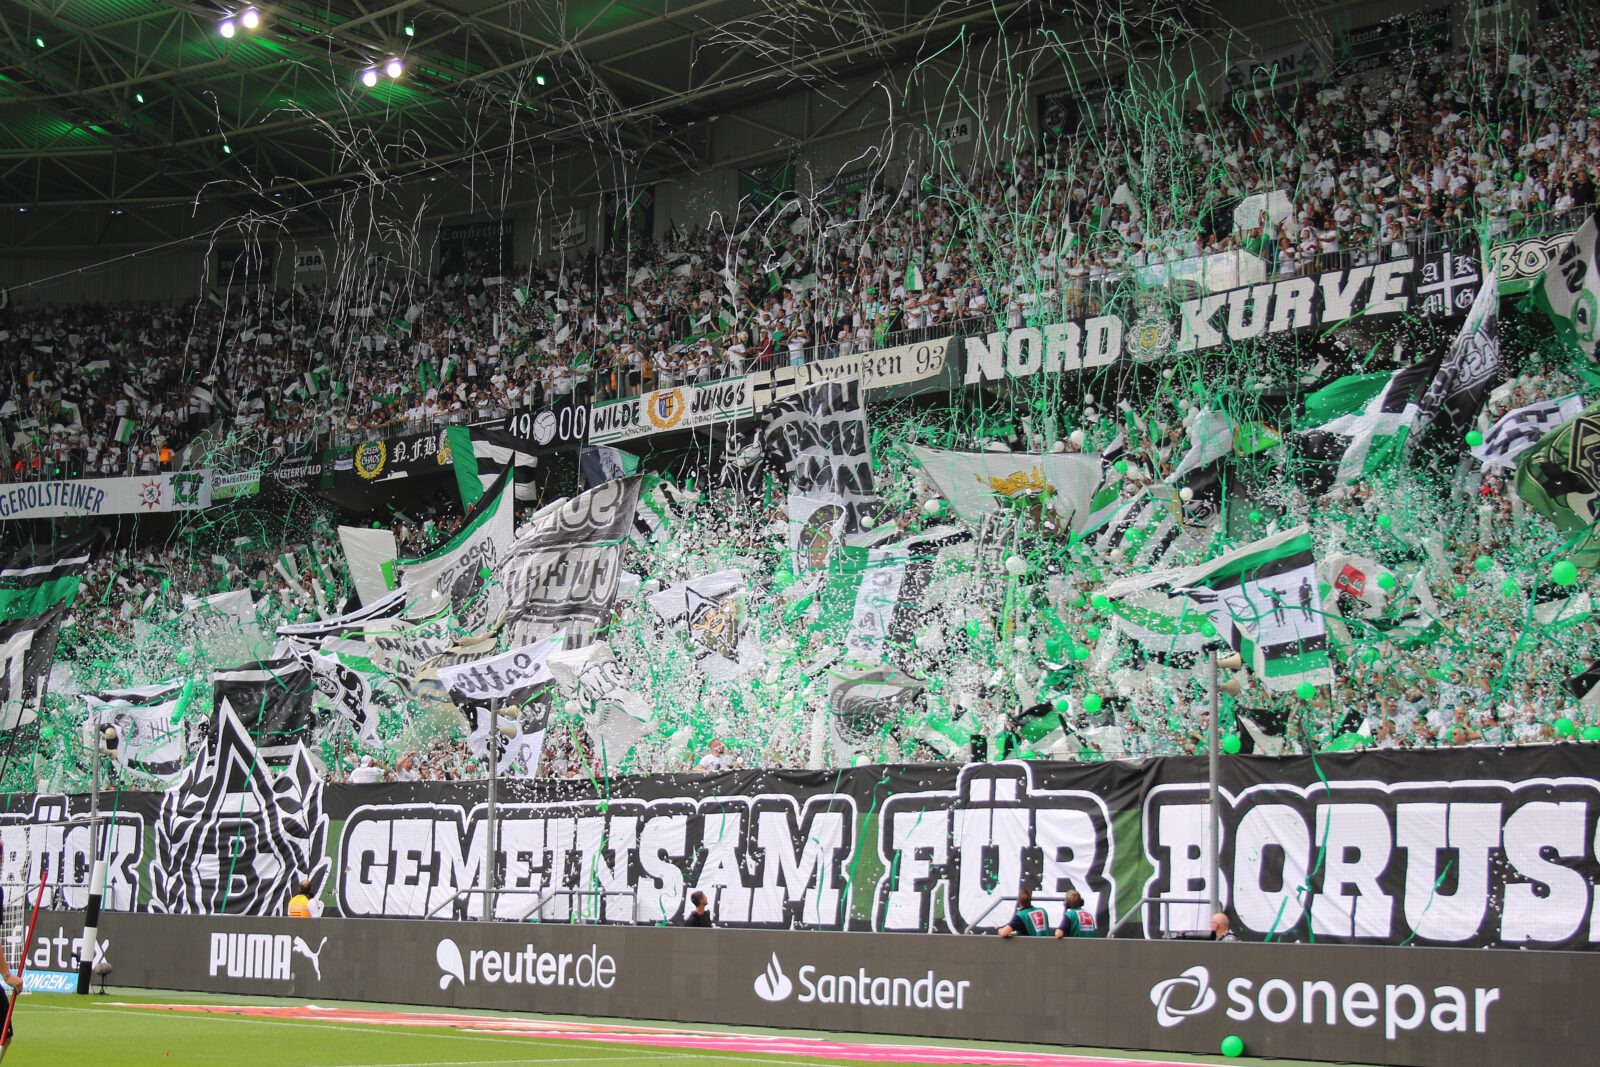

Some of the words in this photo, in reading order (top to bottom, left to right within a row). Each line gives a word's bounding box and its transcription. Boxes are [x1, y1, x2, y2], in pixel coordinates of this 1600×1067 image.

[964, 314, 1123, 385] NORD
[1177, 257, 1414, 352] KURVE
[594, 401, 641, 433] WILDE
[691, 382, 746, 416] JUNGS
[273, 464, 322, 480] WESTERWALD
[0, 483, 105, 517] GEROLSTEINER
[345, 810, 844, 925] GEMEINSAM
[886, 777, 1102, 931] FÜR
[1158, 800, 1600, 942] BORUS
[209, 932, 291, 981] PUMA
[469, 944, 617, 989] reuter.de
[798, 965, 971, 1010] Santander
[1226, 976, 1500, 1040] sonepar
